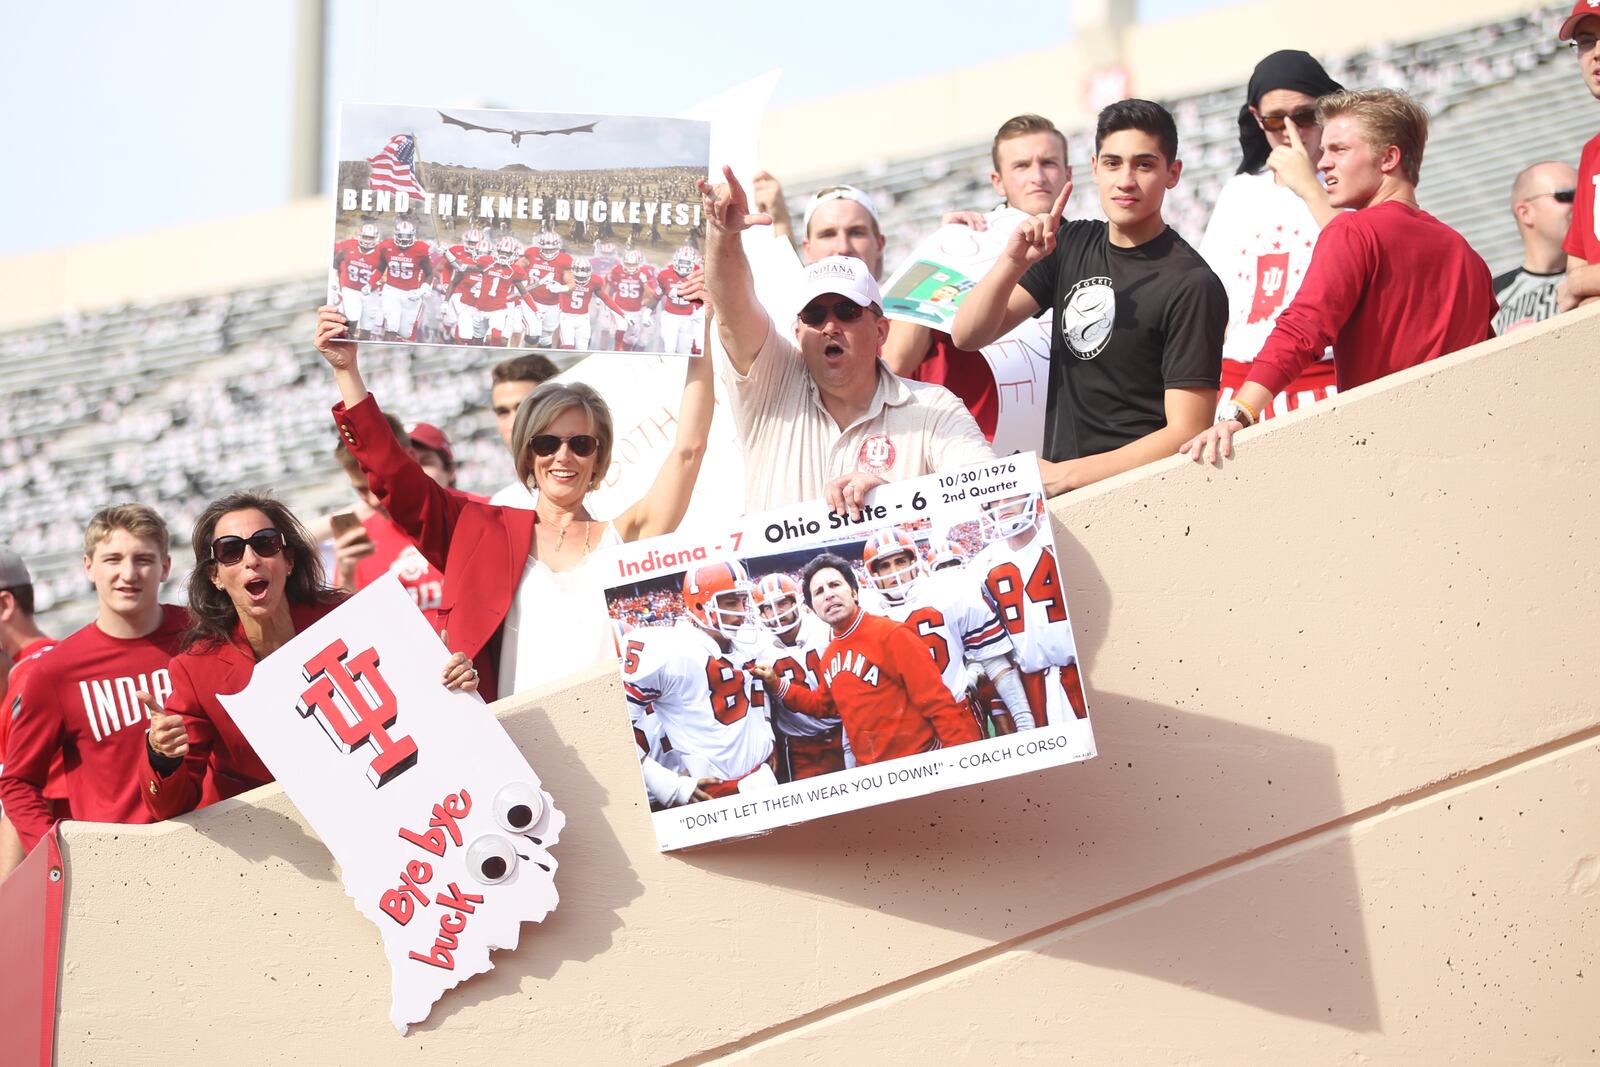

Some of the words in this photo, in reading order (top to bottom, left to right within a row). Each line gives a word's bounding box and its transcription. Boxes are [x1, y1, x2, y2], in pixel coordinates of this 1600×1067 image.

[342, 188, 410, 213] BEND
[423, 192, 468, 216] THE
[479, 195, 544, 220] KNEE
[555, 198, 701, 226] BUCKEYES!
[938, 462, 1016, 488] 10/30/1976
[942, 489, 966, 504] 2nd
[969, 480, 1018, 498] Quarter
[765, 517, 821, 543] Ohio
[912, 491, 927, 511] 6
[618, 546, 707, 578] Indiana
[729, 532, 744, 552] 7
[733, 802, 759, 819] LET
[763, 793, 805, 812] THEM
[806, 783, 849, 803] WEAR
[851, 775, 884, 792] YOU
[887, 762, 944, 785] DOWN!"
[958, 747, 1013, 769] COACH
[1016, 735, 1068, 757] CORSO
[398, 788, 473, 858] bye
[379, 859, 434, 927] Bye
[408, 882, 485, 971] buck
